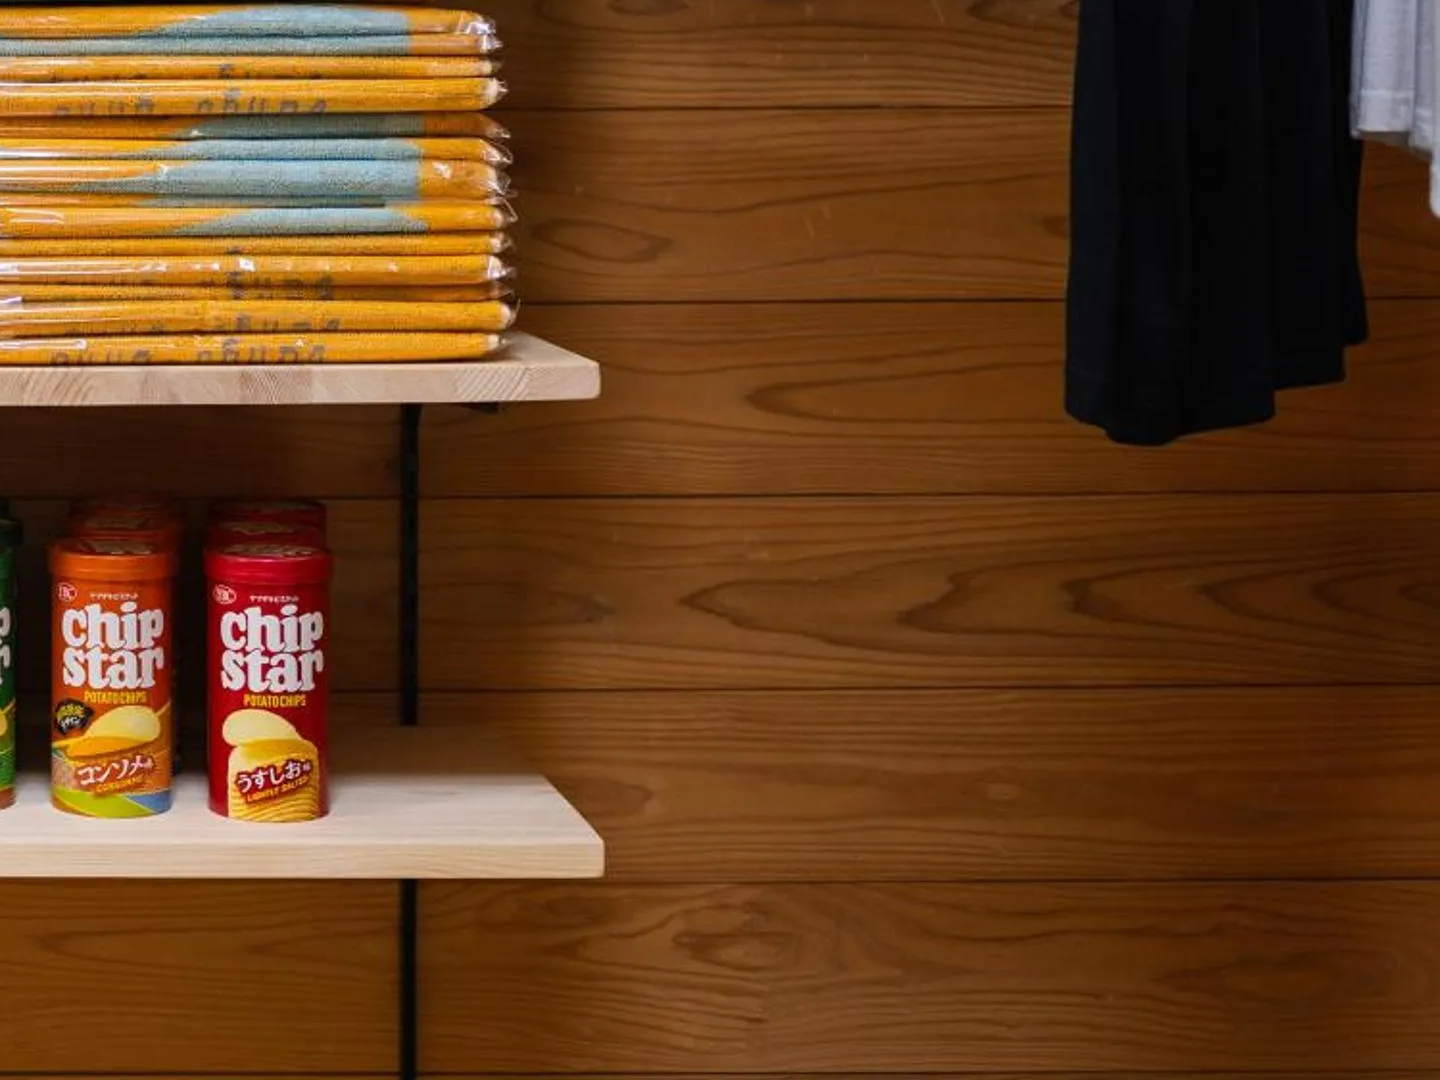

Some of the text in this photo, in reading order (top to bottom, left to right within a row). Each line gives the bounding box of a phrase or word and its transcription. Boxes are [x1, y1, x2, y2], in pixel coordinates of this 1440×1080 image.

[62, 602, 164, 649] chip
[221, 604, 324, 653] chip
[63, 646, 164, 689] star
[222, 649, 324, 693] star
